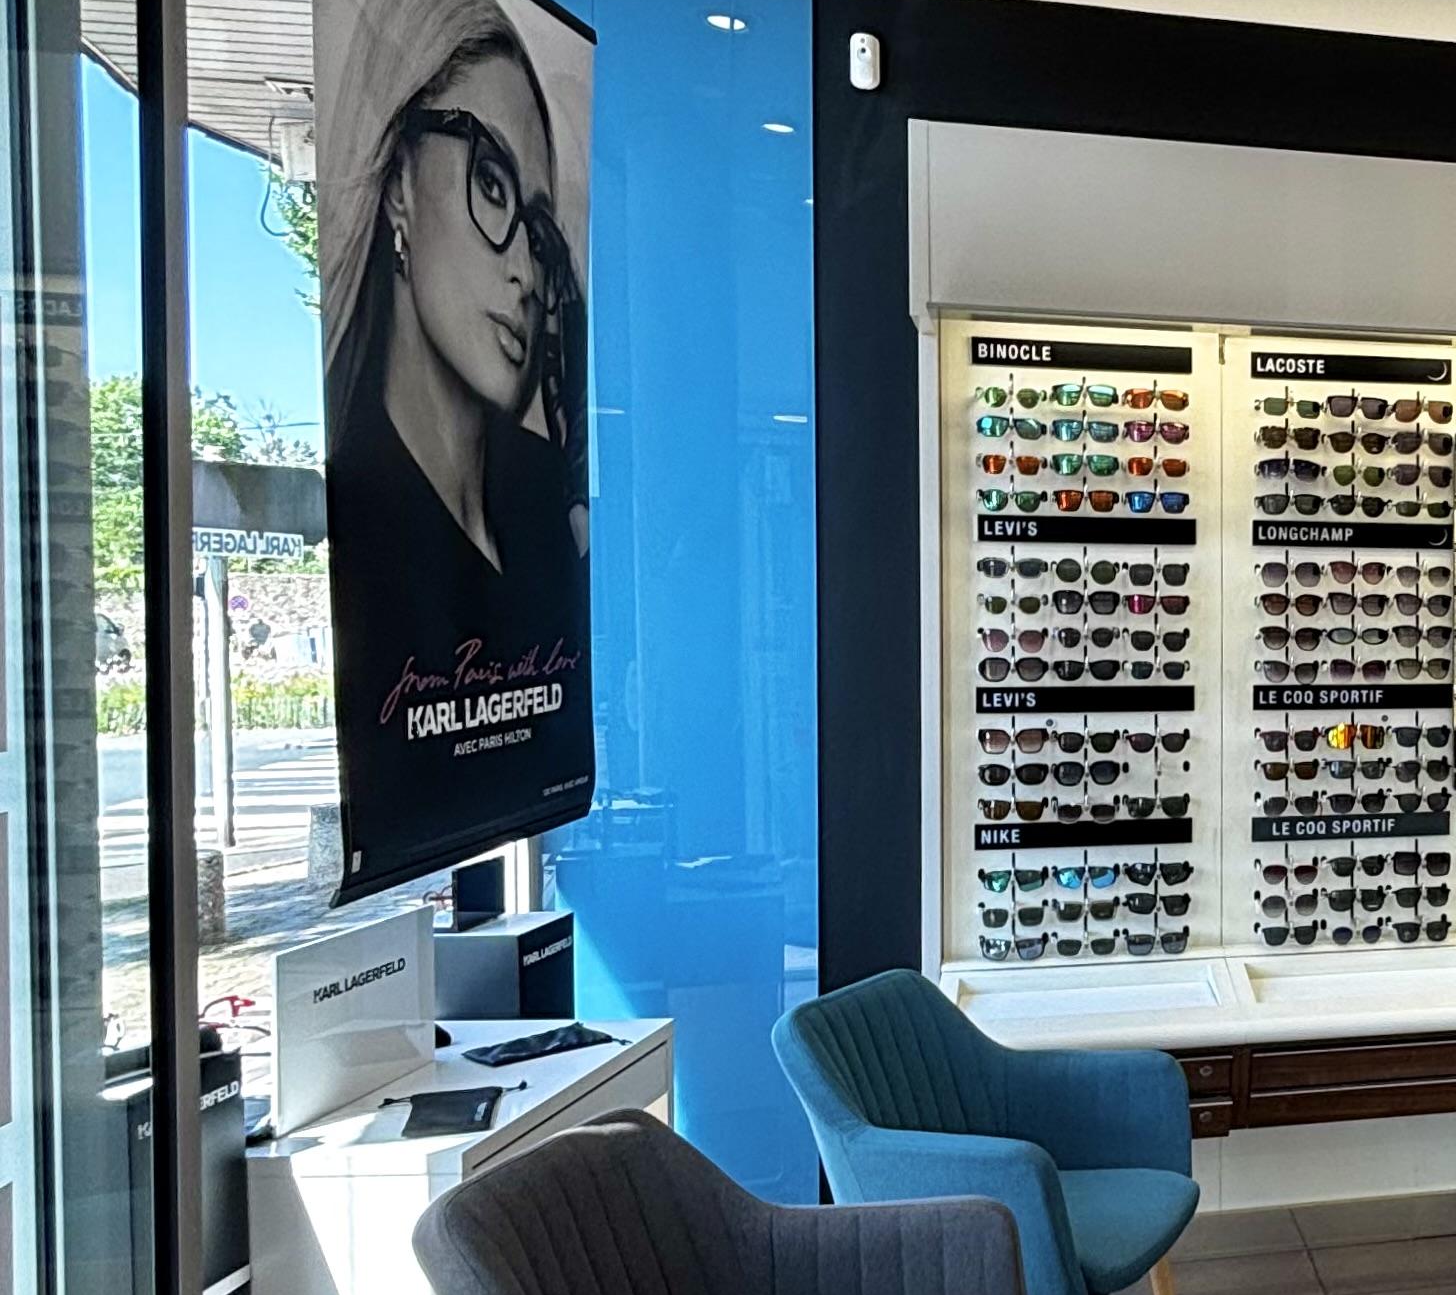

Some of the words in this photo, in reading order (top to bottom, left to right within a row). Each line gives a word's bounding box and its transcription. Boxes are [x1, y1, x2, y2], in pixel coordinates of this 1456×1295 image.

[977, 342, 1052, 362] BINOCLE
[1256, 357, 1325, 374] LACOSTE
[983, 520, 1038, 537] LEVI'S
[1257, 525, 1354, 543] LONGCHAMP
[453, 638, 504, 691] Paris
[982, 692, 1036, 708] LEVI'S
[1259, 690, 1277, 704] LE
[1283, 690, 1314, 705] COQ
[1319, 689, 1384, 704] SPORTIF
[407, 700, 464, 741] KARL
[464, 682, 563, 729] LAGERFELD
[453, 739, 479, 757] AVEC
[478, 733, 504, 751] PARIS
[504, 727, 533, 747] HILTON
[1272, 822, 1290, 836] LE
[1296, 820, 1326, 835] COQ
[1331, 818, 1396, 834] SPORTIF
[980, 828, 1020, 845] NIKE
[522, 950, 540, 967] KARL
[540, 935, 573, 958] LAGERFELD
[313, 983, 344, 1004] KARL
[344, 957, 407, 992] LAGERFELD
